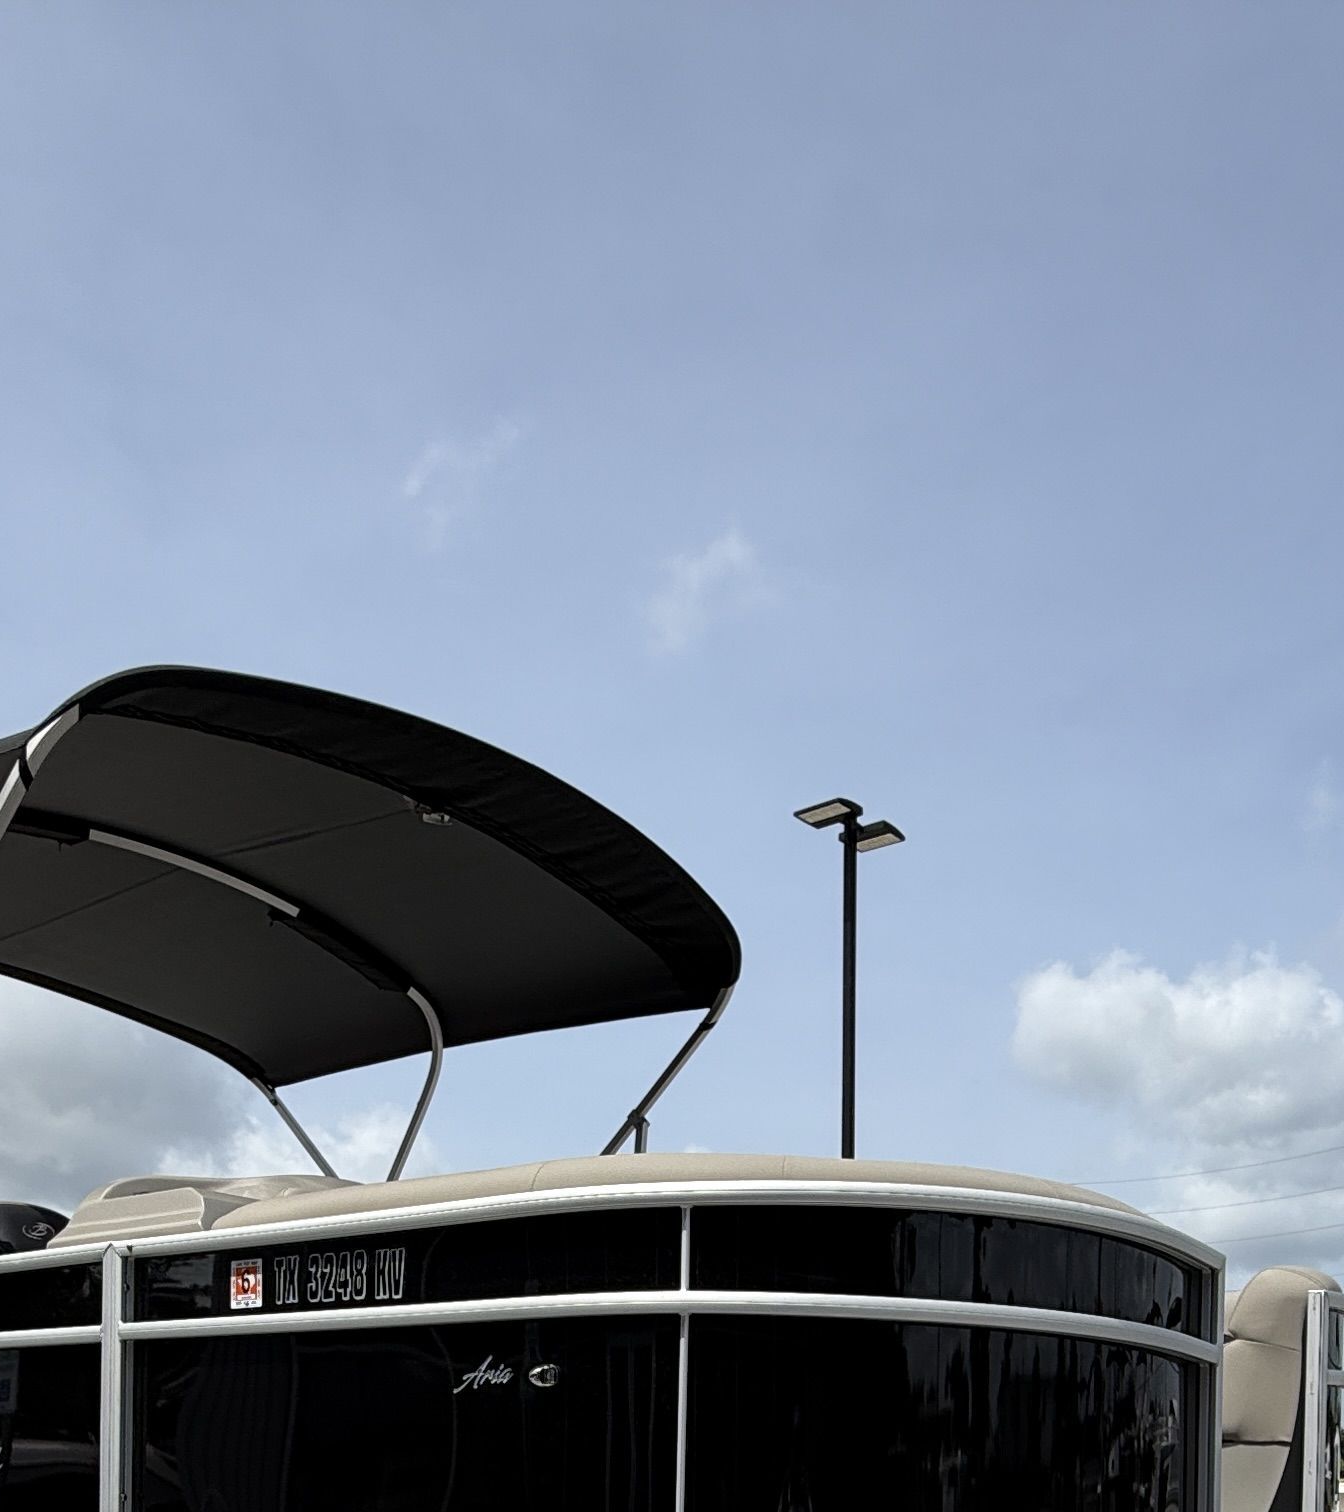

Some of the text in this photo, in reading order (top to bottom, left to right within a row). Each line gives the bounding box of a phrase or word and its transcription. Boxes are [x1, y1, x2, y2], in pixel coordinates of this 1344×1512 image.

[274, 1255, 300, 1305] TX
[307, 1249, 367, 1303] 3248
[375, 1248, 405, 1300] KV
[453, 1354, 514, 1394] Aria
